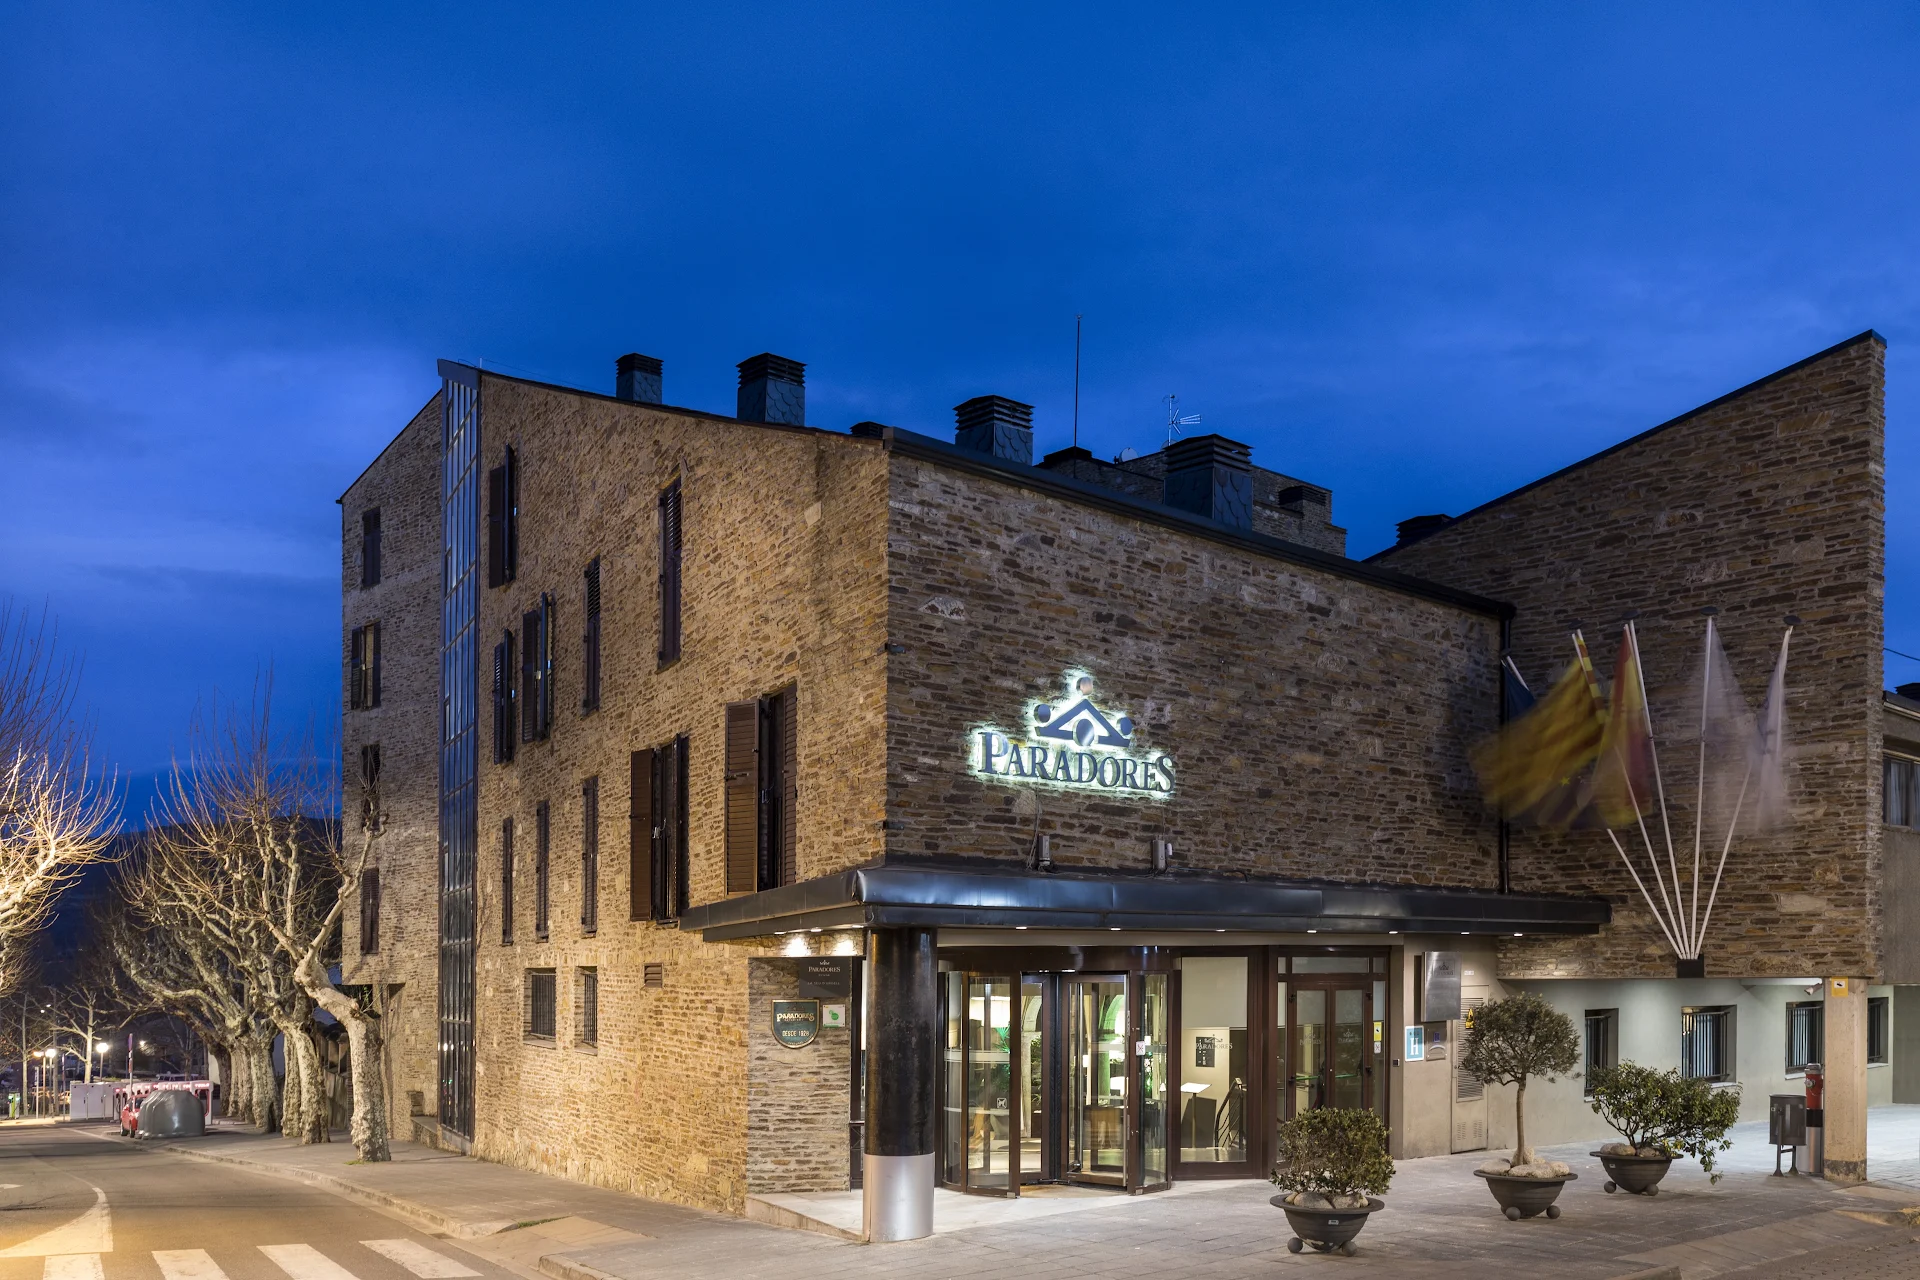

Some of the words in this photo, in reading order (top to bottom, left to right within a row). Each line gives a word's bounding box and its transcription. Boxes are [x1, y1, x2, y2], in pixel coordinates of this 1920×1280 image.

[978, 731, 1177, 792] PARADORES
[776, 1012, 815, 1022] PARADORES
[1195, 1042, 1233, 1050] PARADORES
[1409, 1037, 1420, 1056] H
